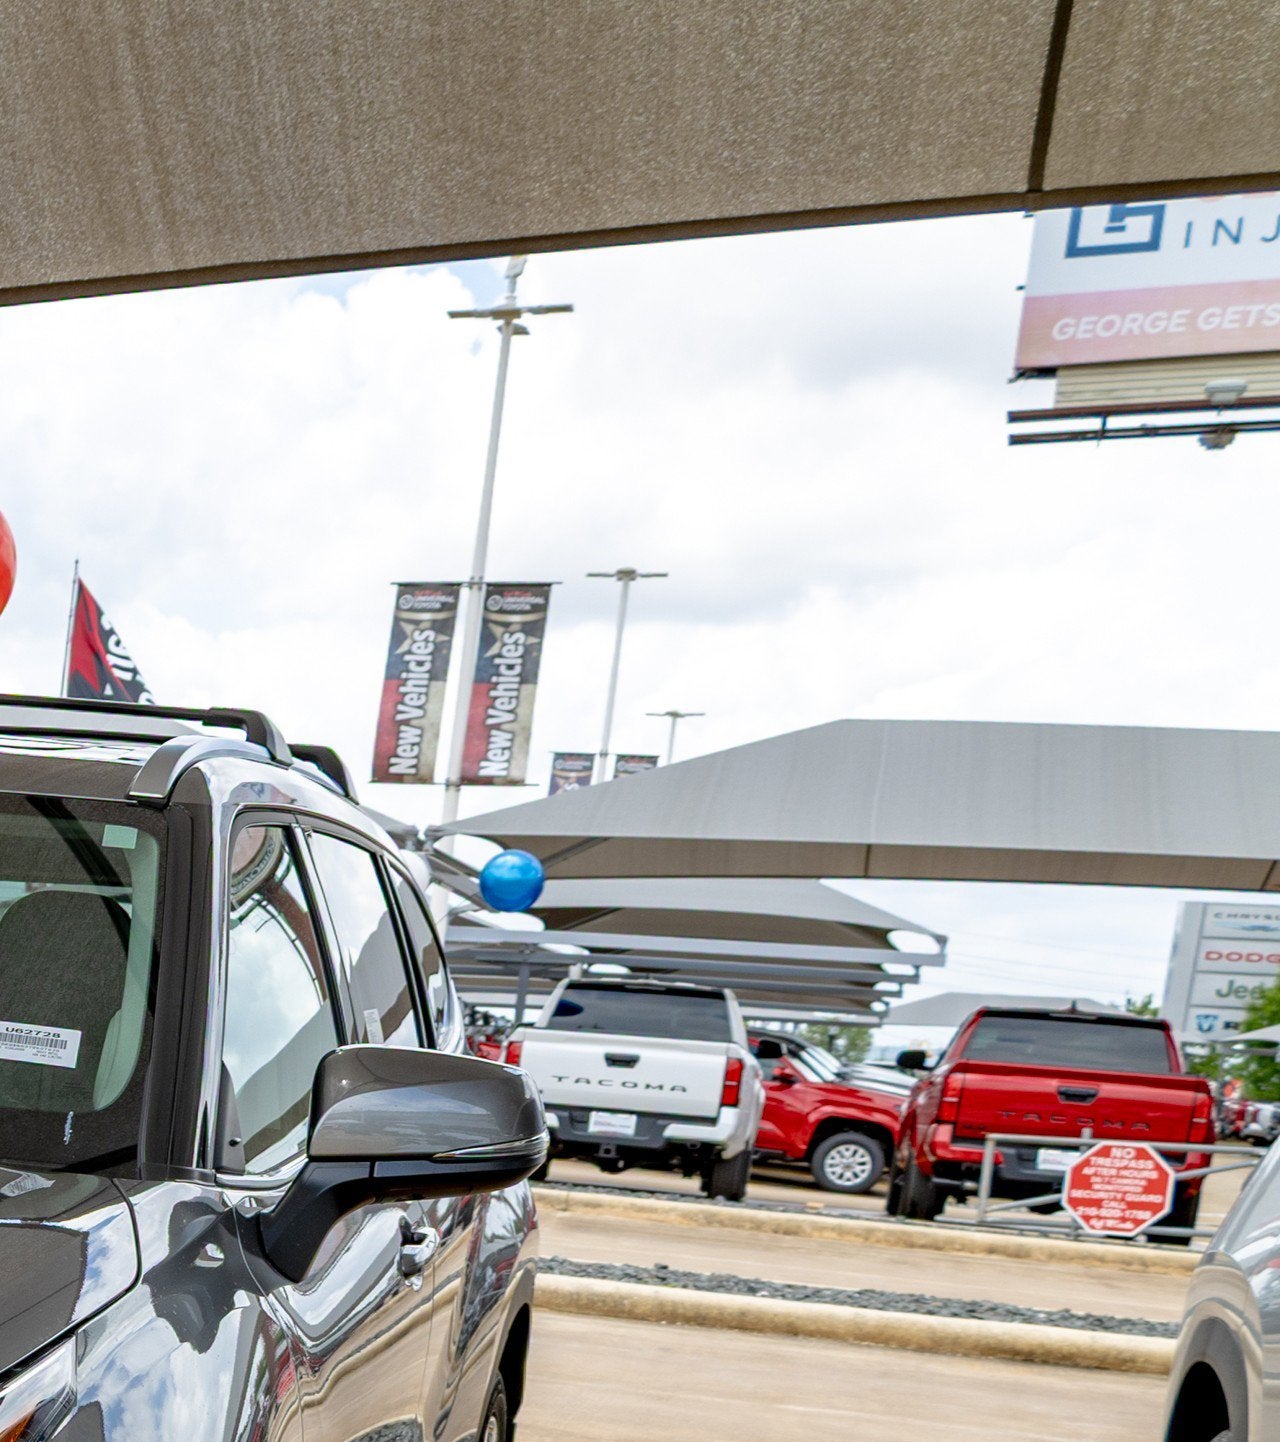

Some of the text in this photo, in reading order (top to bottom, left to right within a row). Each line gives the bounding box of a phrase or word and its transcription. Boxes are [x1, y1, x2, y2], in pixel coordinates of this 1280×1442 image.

[1051, 303, 1280, 341] GEORGE GETS
[395, 629, 436, 721] Vehicles
[486, 631, 527, 725] Vehicles
[389, 725, 423, 775] New
[478, 729, 514, 777] New
[1215, 980, 1266, 1000] Jee
[5, 1027, 61, 1038] U62728
[552, 1075, 688, 1093] TACOMA
[997, 1111, 1150, 1131] TACOMA
[1110, 1146, 1137, 1159] NO
[1081, 1166, 1158, 1179] AFTER HOURS
[1090, 1157, 1155, 1169] TRESPASS
[1070, 1189, 1163, 1203] SECURITY GUARD
